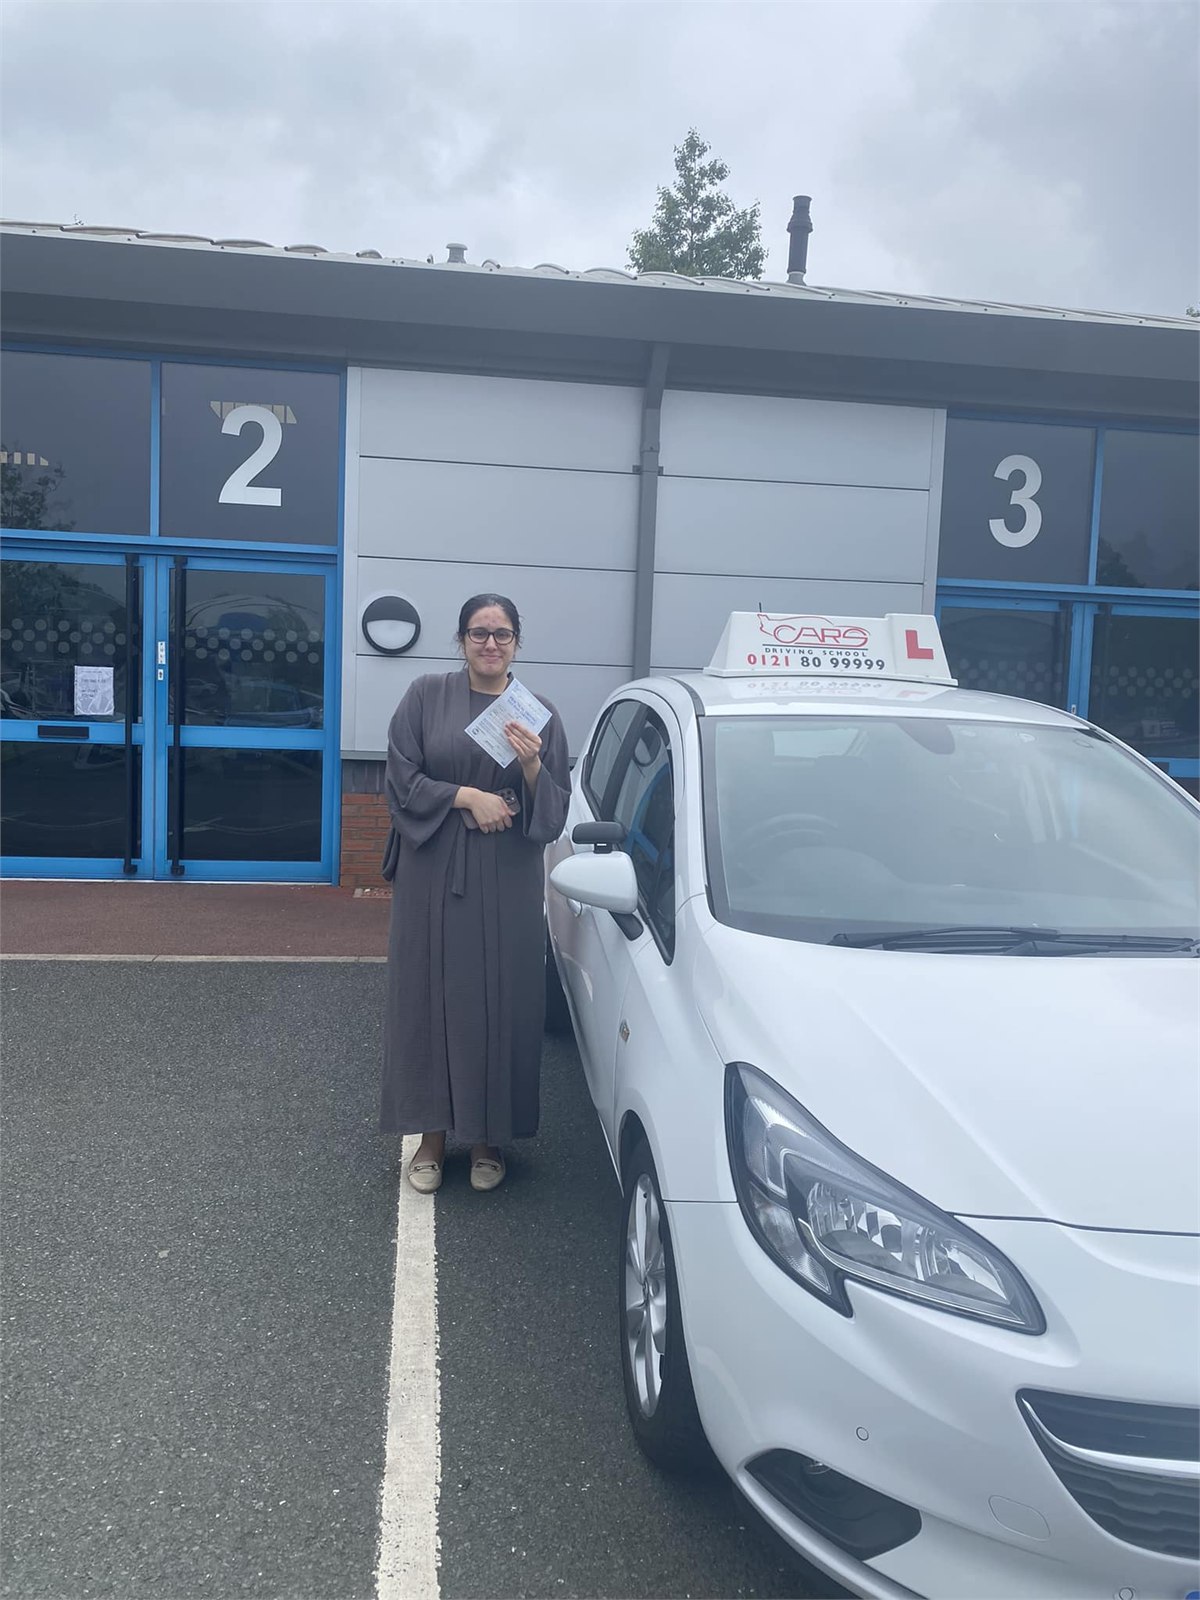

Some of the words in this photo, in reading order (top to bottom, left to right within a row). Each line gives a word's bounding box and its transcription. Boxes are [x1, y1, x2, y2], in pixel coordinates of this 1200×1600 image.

[219, 405, 282, 506] 2
[989, 454, 1042, 548] 3
[774, 625, 868, 648] CARS
[905, 630, 934, 660] L
[747, 654, 790, 667] 0121
[800, 656, 822, 668] 80
[830, 657, 885, 670] 99999
